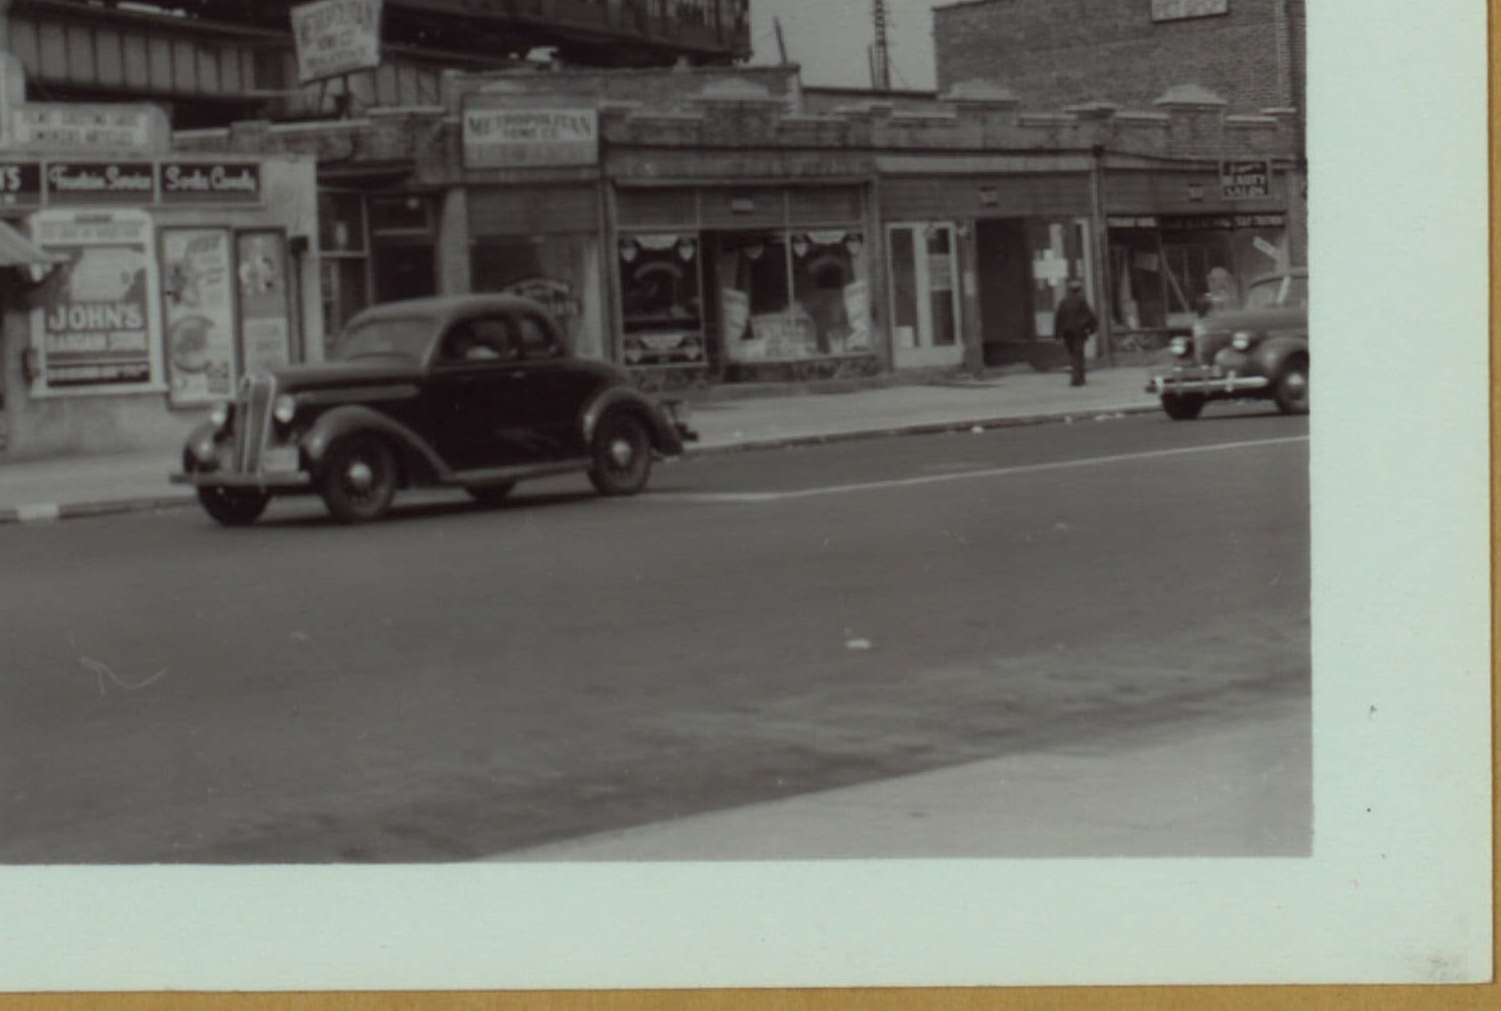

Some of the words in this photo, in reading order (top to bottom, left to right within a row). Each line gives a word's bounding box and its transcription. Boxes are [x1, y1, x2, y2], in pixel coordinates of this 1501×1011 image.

[165, 166, 209, 191] Soda
[211, 166, 256, 195] Candy
[48, 303, 143, 331] JOHN'S
